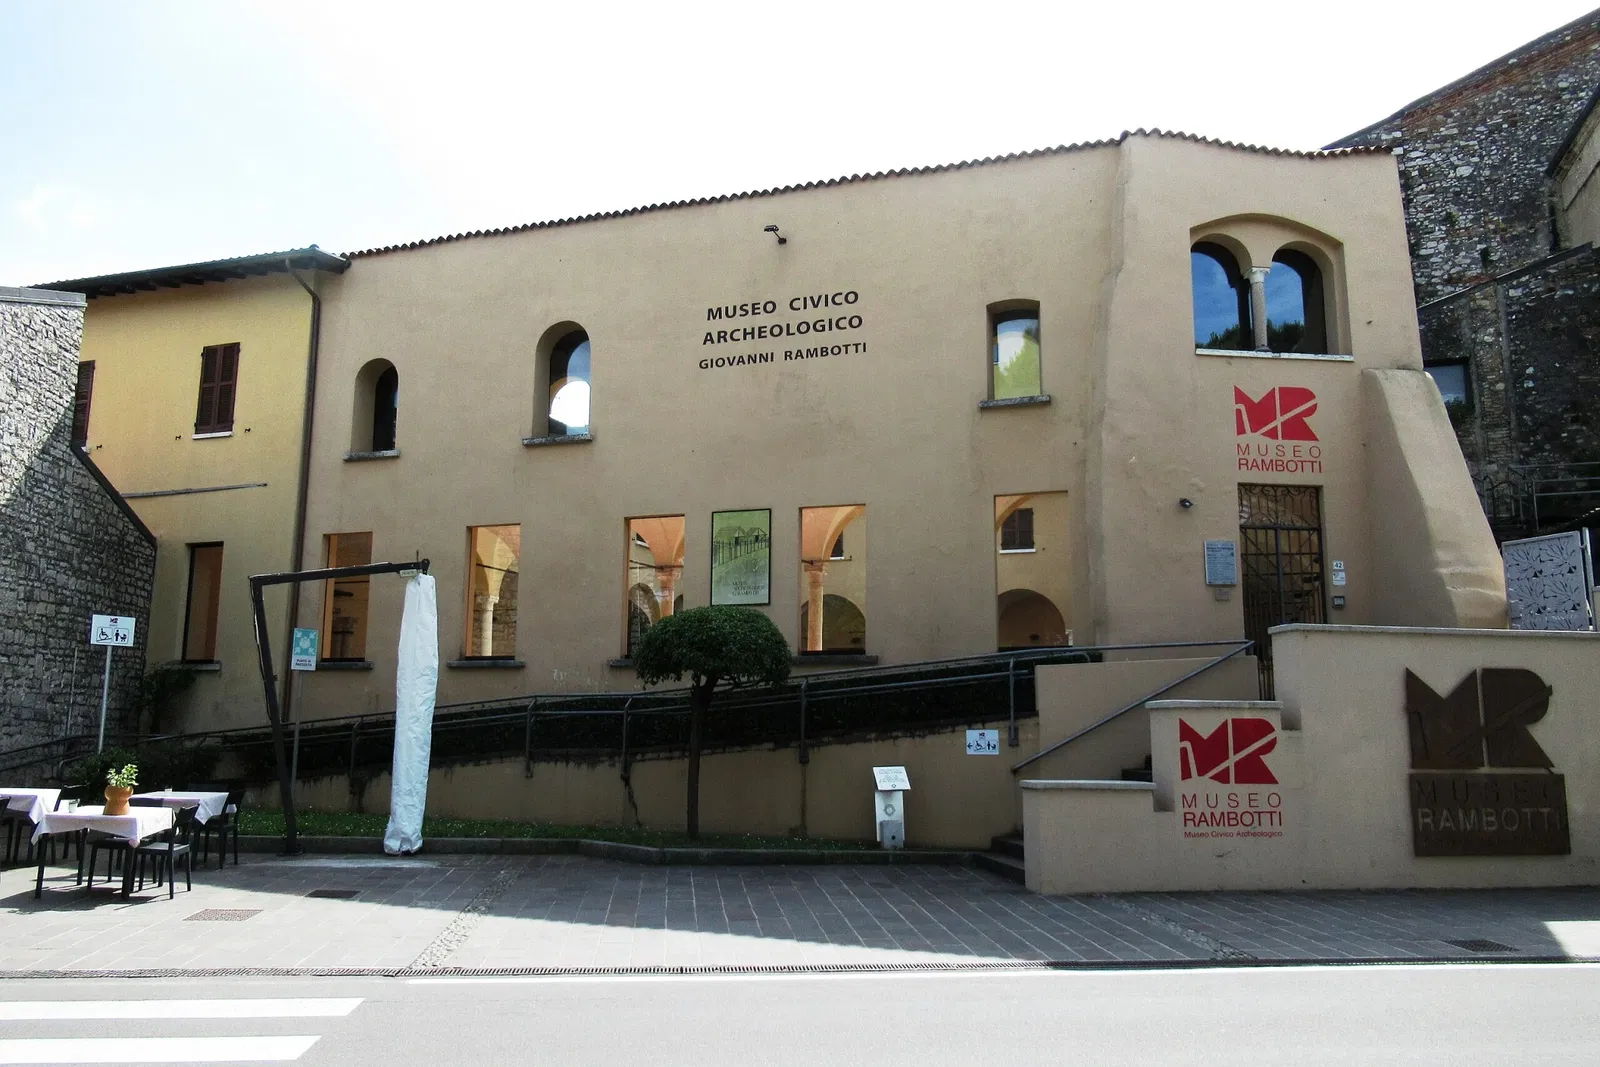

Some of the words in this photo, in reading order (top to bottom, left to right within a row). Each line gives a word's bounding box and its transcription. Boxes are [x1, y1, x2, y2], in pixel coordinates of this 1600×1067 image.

[707, 300, 777, 321] MUSEO
[789, 291, 859, 311] CIVICO
[702, 315, 863, 345] ARCHEOLOGICO
[699, 352, 774, 370] GIOVANNI
[784, 342, 867, 361] RAMBOTTI
[1237, 443, 1321, 458] MUSEO
[1238, 458, 1322, 473] RAMBOTTI
[1182, 793, 1281, 808] MUSEO
[1183, 811, 1282, 827] RAMBOTTI
[1417, 808, 1562, 832] RAMBOTTI
[1211, 830, 1234, 838] Civico
[1236, 830, 1282, 839] Archeologico
